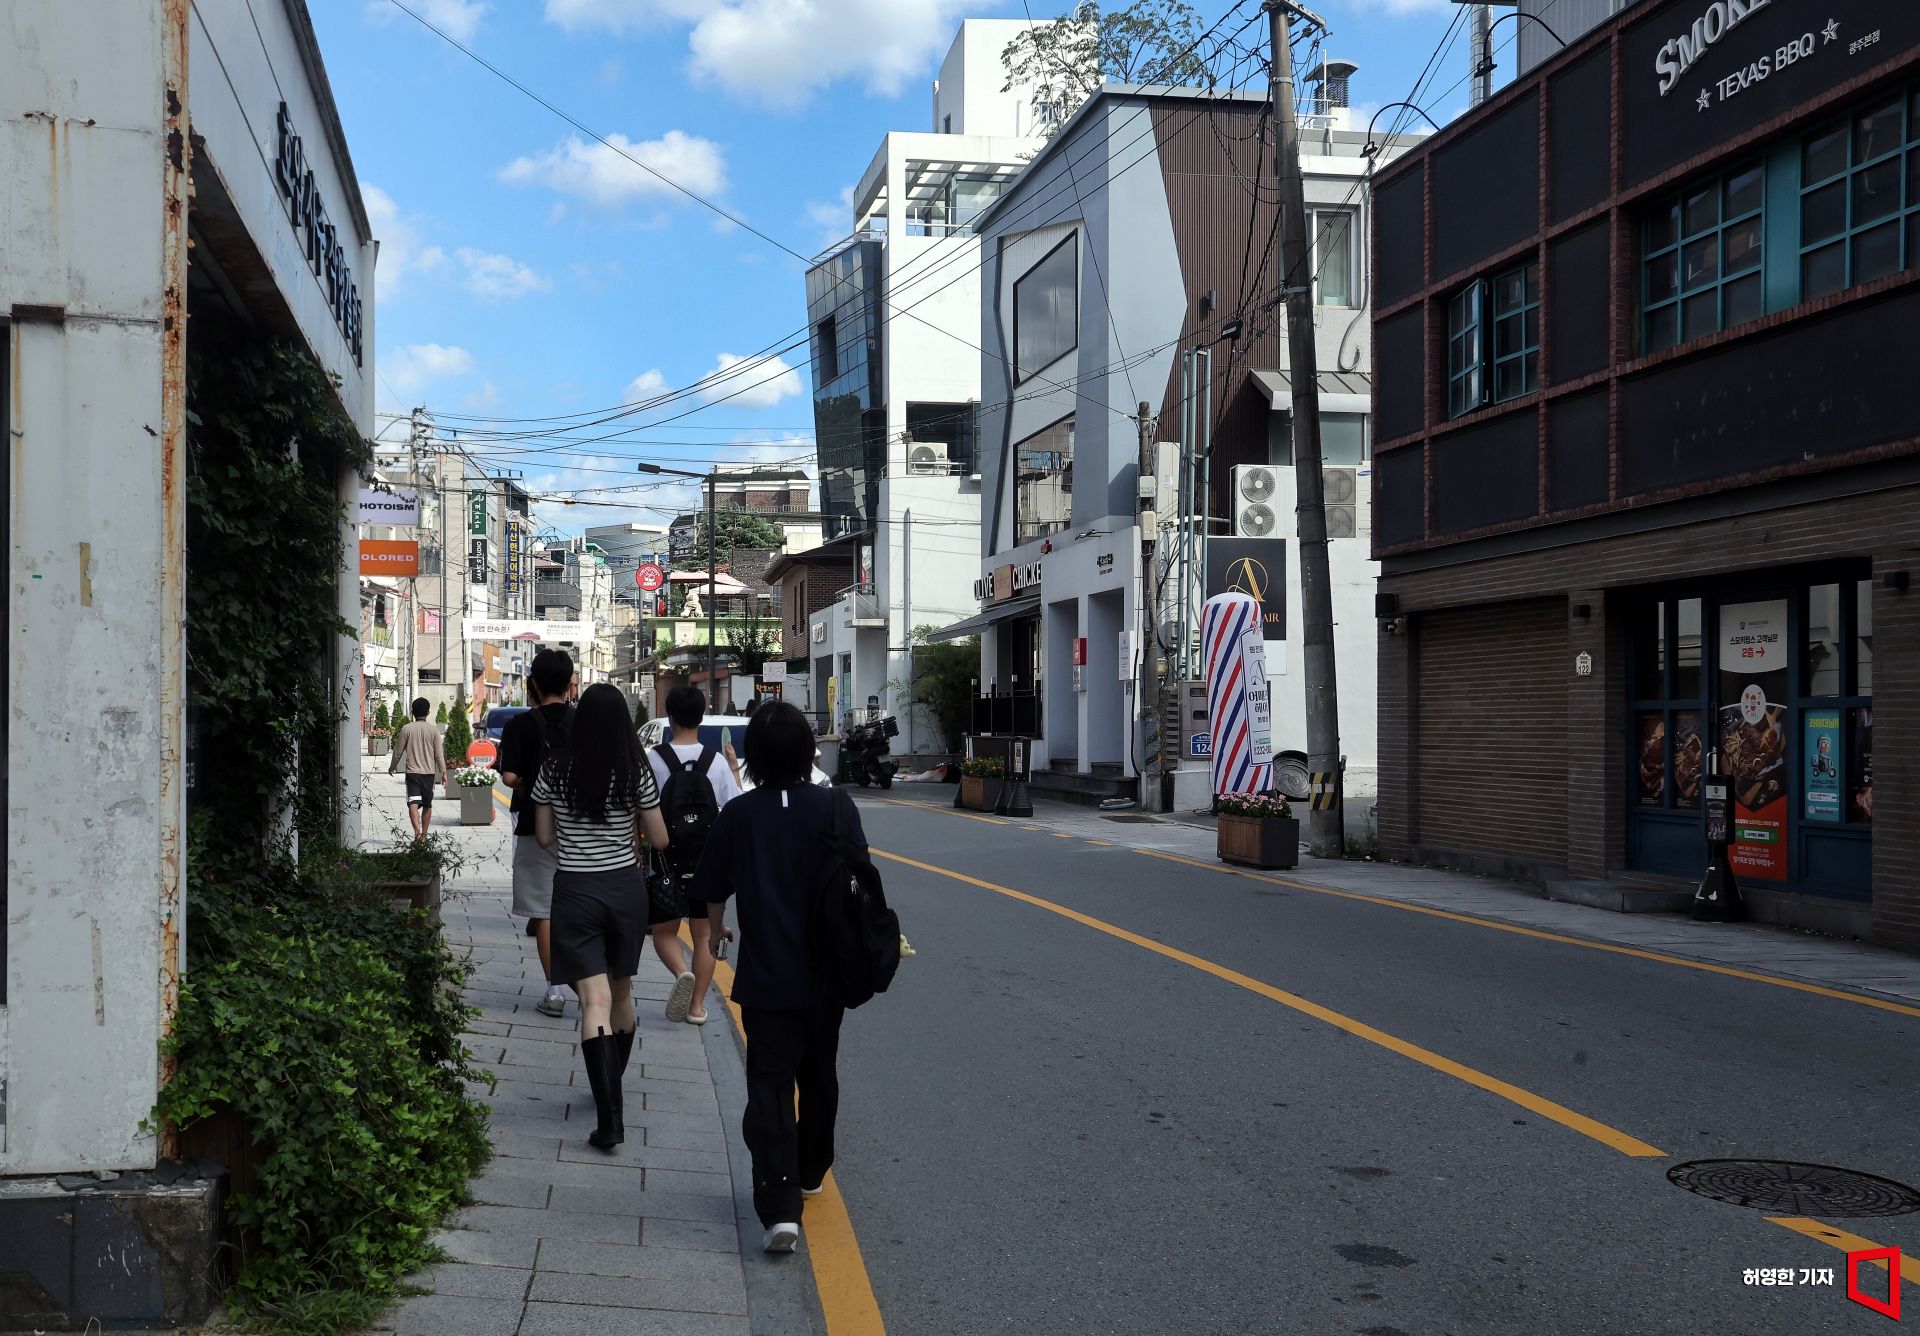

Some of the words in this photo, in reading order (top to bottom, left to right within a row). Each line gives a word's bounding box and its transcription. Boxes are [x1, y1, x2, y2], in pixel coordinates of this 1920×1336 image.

[1655, 0, 1771, 96] SMOK
[1848, 29, 1881, 55] 광주본점
[1715, 55, 1772, 101] TEXAS
[1775, 32, 1816, 72] BBQ
[974, 573, 994, 601] OLIVE
